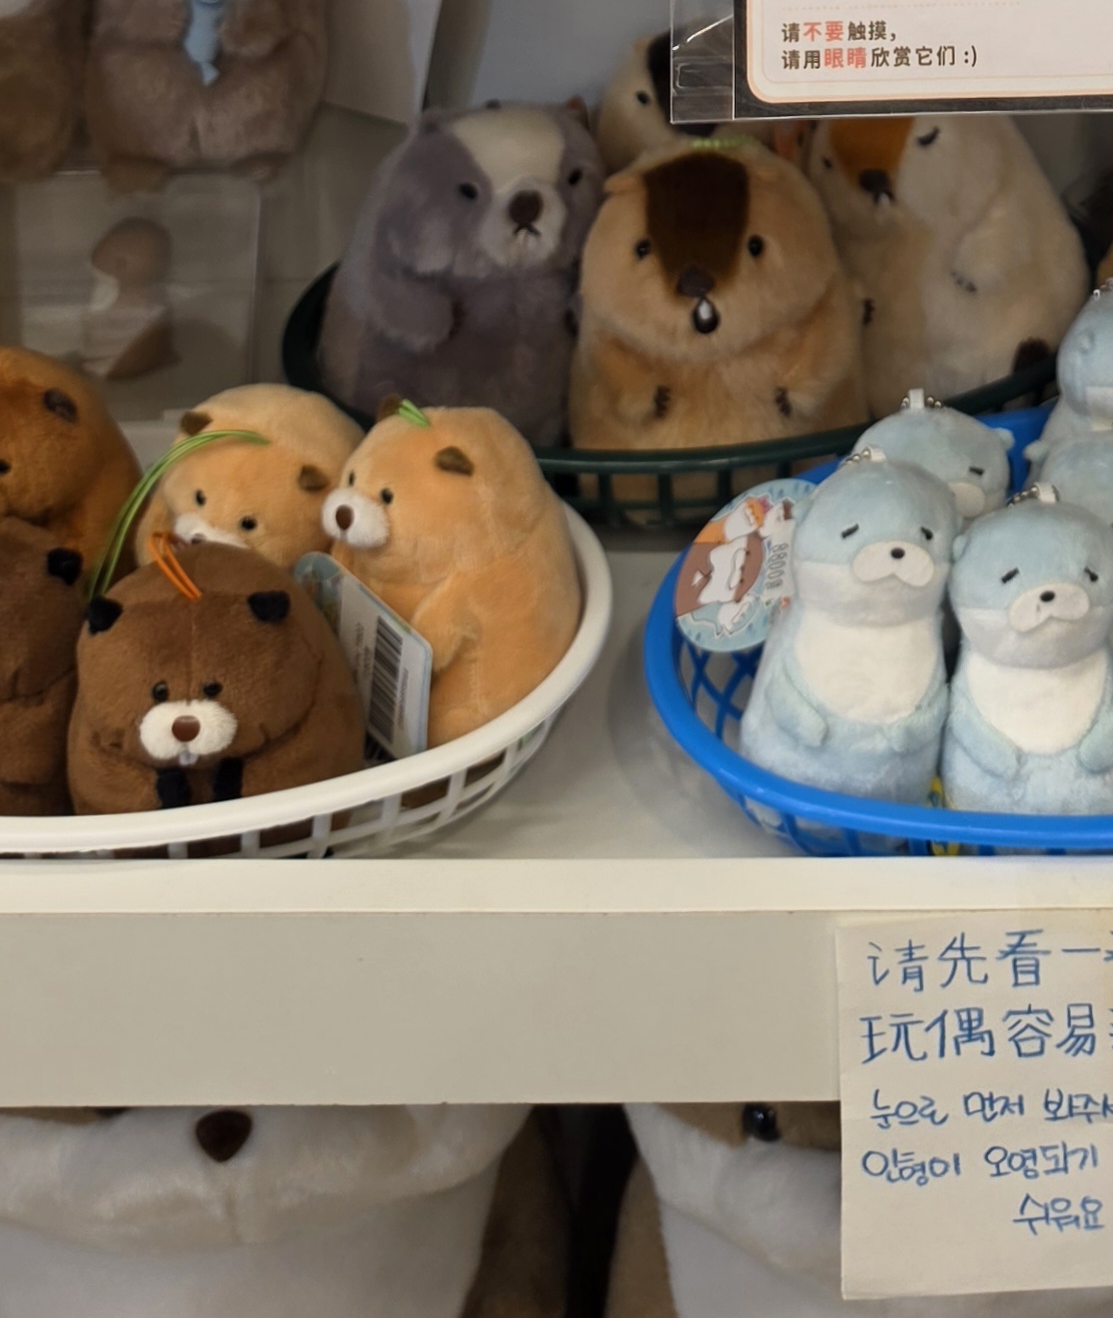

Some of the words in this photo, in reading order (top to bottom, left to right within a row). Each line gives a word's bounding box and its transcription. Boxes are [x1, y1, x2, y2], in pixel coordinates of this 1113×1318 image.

[781, 45, 956, 70] 请用眼睛欣赏它们
[870, 1088, 950, 1129] 눈으로
[963, 1091, 1025, 1123] 먼저
[861, 1148, 961, 1187] 인형이
[1012, 1192, 1105, 1236] 쉬워요
